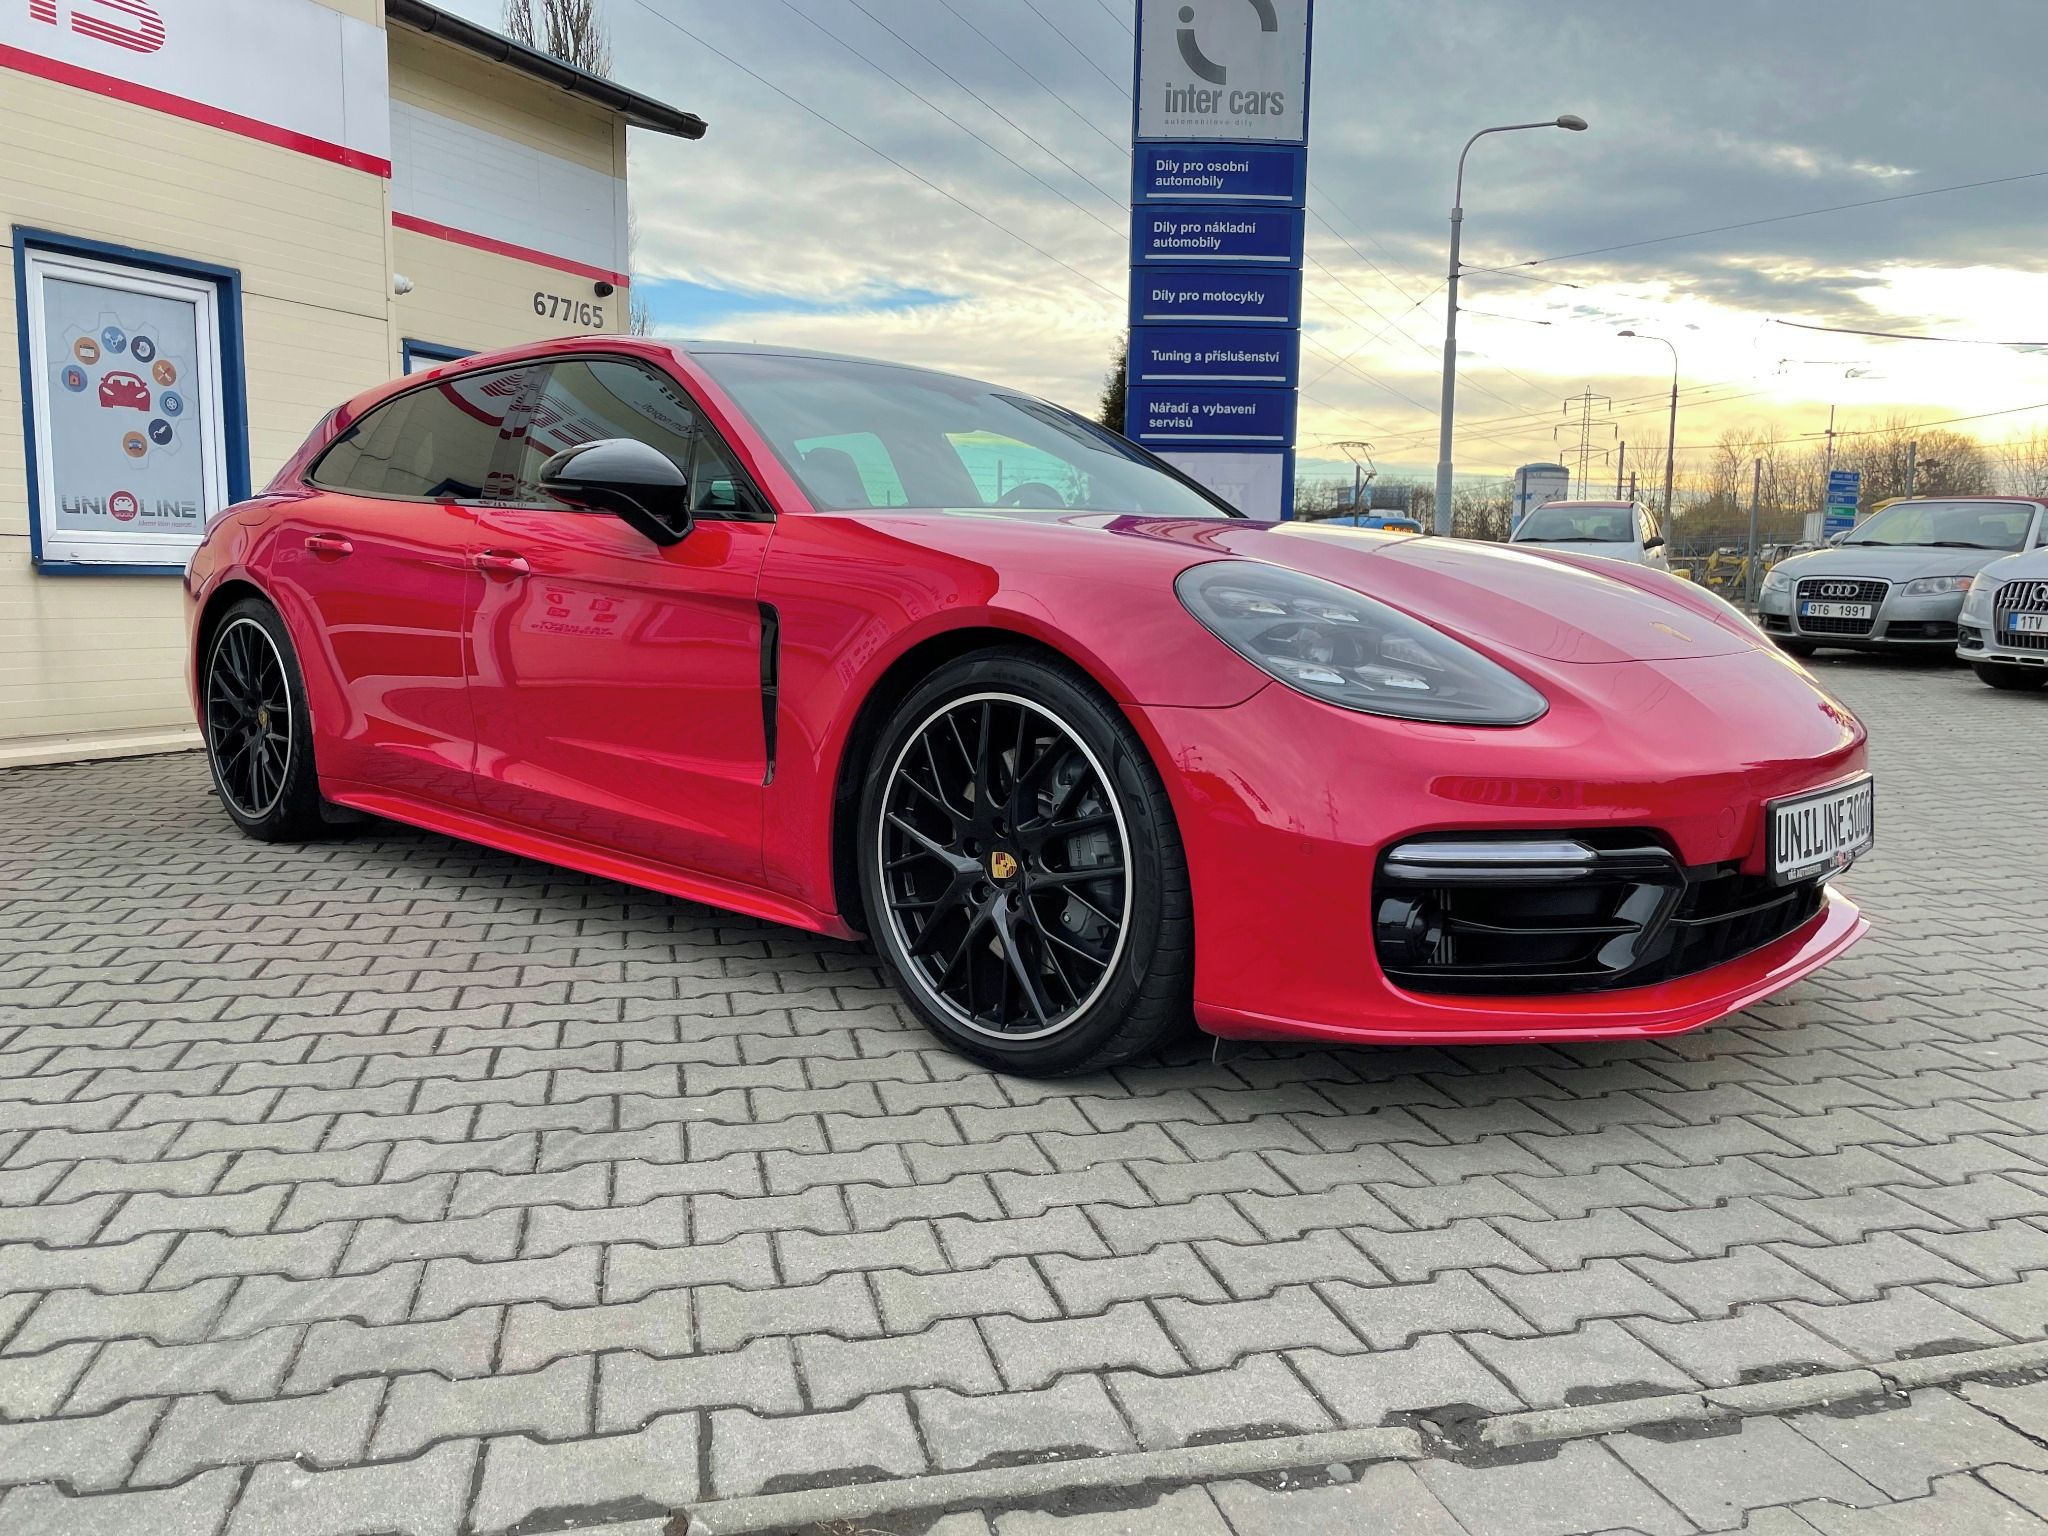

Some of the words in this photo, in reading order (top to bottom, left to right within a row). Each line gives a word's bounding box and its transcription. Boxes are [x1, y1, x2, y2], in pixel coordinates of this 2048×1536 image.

[1165, 82, 1222, 114] inter
[1230, 90, 1284, 116] cars
[1156, 160, 1179, 173] Díly
[1183, 162, 1203, 173] pro
[1207, 161, 1249, 172] osobní
[1156, 176, 1223, 189] automobily
[1154, 222, 1176, 234] Díly
[1180, 225, 1201, 234] pro
[1205, 222, 1256, 234] nákladní
[1153, 237, 1221, 250] automobily
[1152, 290, 1175, 302] Díly
[1179, 292, 1199, 302] pro
[1203, 290, 1264, 304] motocykly
[533, 292, 603, 328] 677/65
[1152, 350, 1192, 363] Tuning
[1194, 353, 1202, 362] a
[1205, 350, 1280, 364] příslušenství
[1150, 402, 1188, 414] Nářadí
[1192, 406, 1199, 414] a
[1203, 403, 1256, 417] vybavení
[1149, 417, 1192, 428] servisů
[1810, 604, 1829, 615] 9T6
[1839, 606, 1865, 616] 1991
[2021, 616, 2042, 630] 1TV
